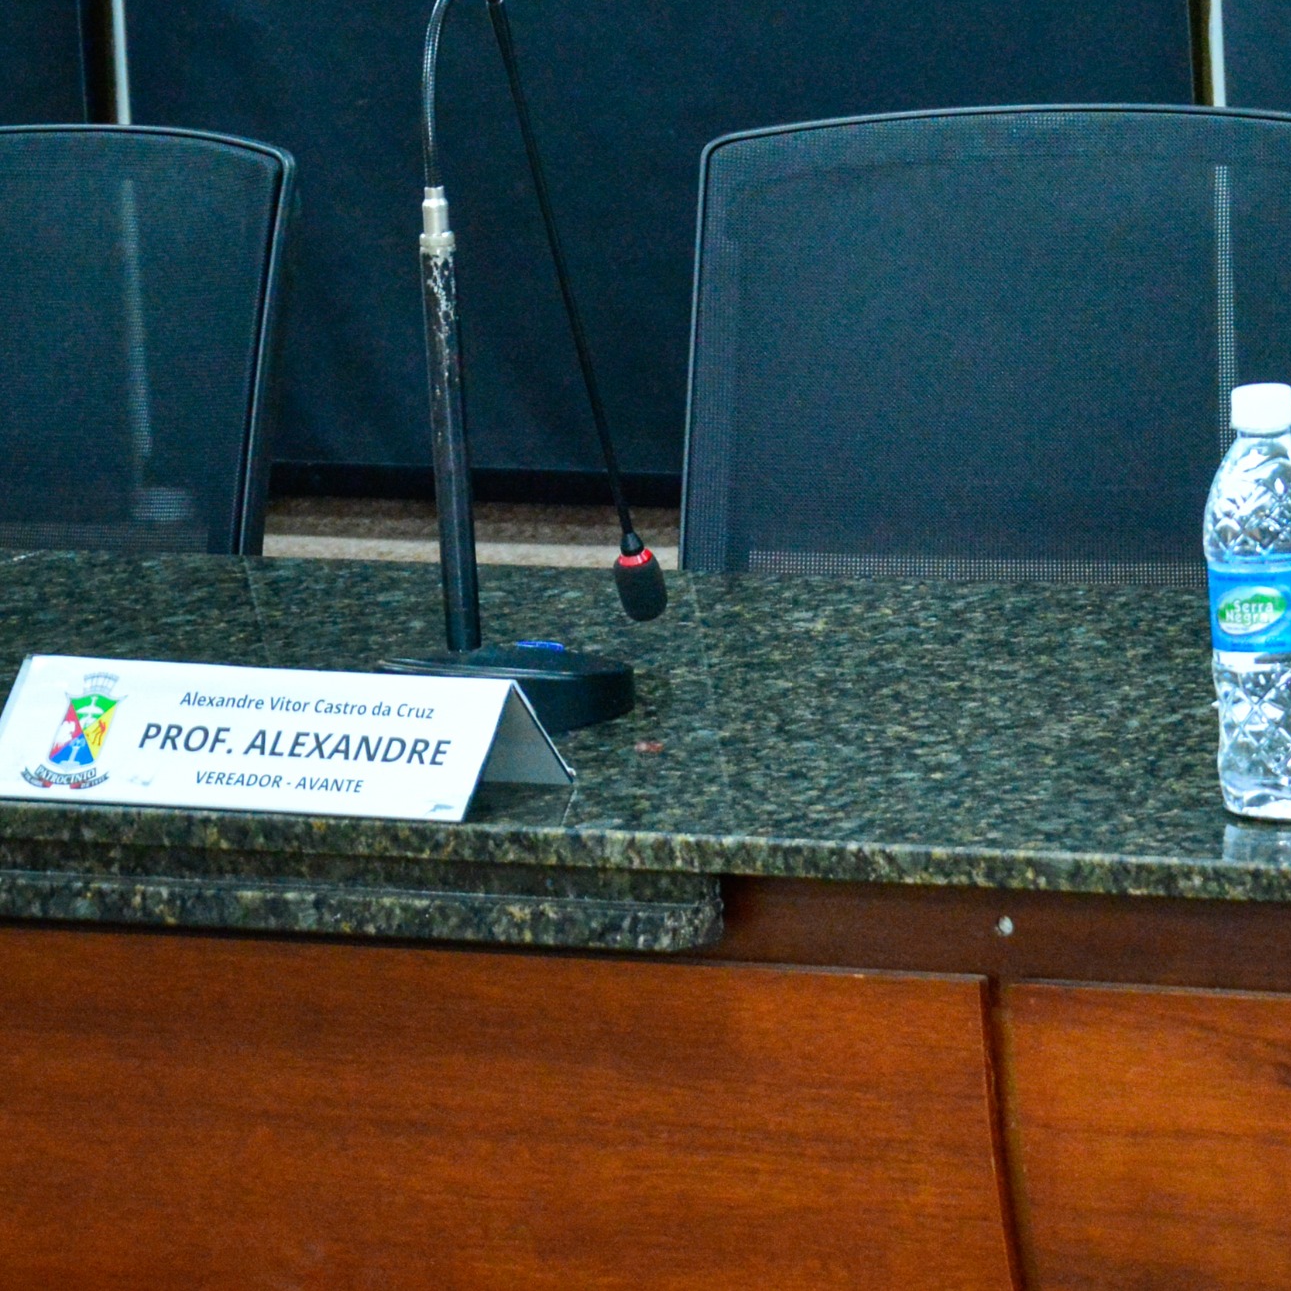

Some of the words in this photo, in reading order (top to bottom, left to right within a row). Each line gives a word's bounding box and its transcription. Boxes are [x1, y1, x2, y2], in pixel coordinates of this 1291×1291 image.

[1233, 599, 1274, 613] Serra
[1225, 611, 1271, 627] Negra
[179, 691, 265, 710] Alexandre
[270, 696, 310, 713] Vitor
[314, 699, 367, 716] Castro
[371, 701, 392, 717] da
[396, 703, 435, 720] Cruz
[138, 722, 234, 755] PROF.
[242, 729, 453, 766] ALEXANDRE
[196, 770, 283, 789] VEREADOR
[295, 776, 364, 793] AVANTE
